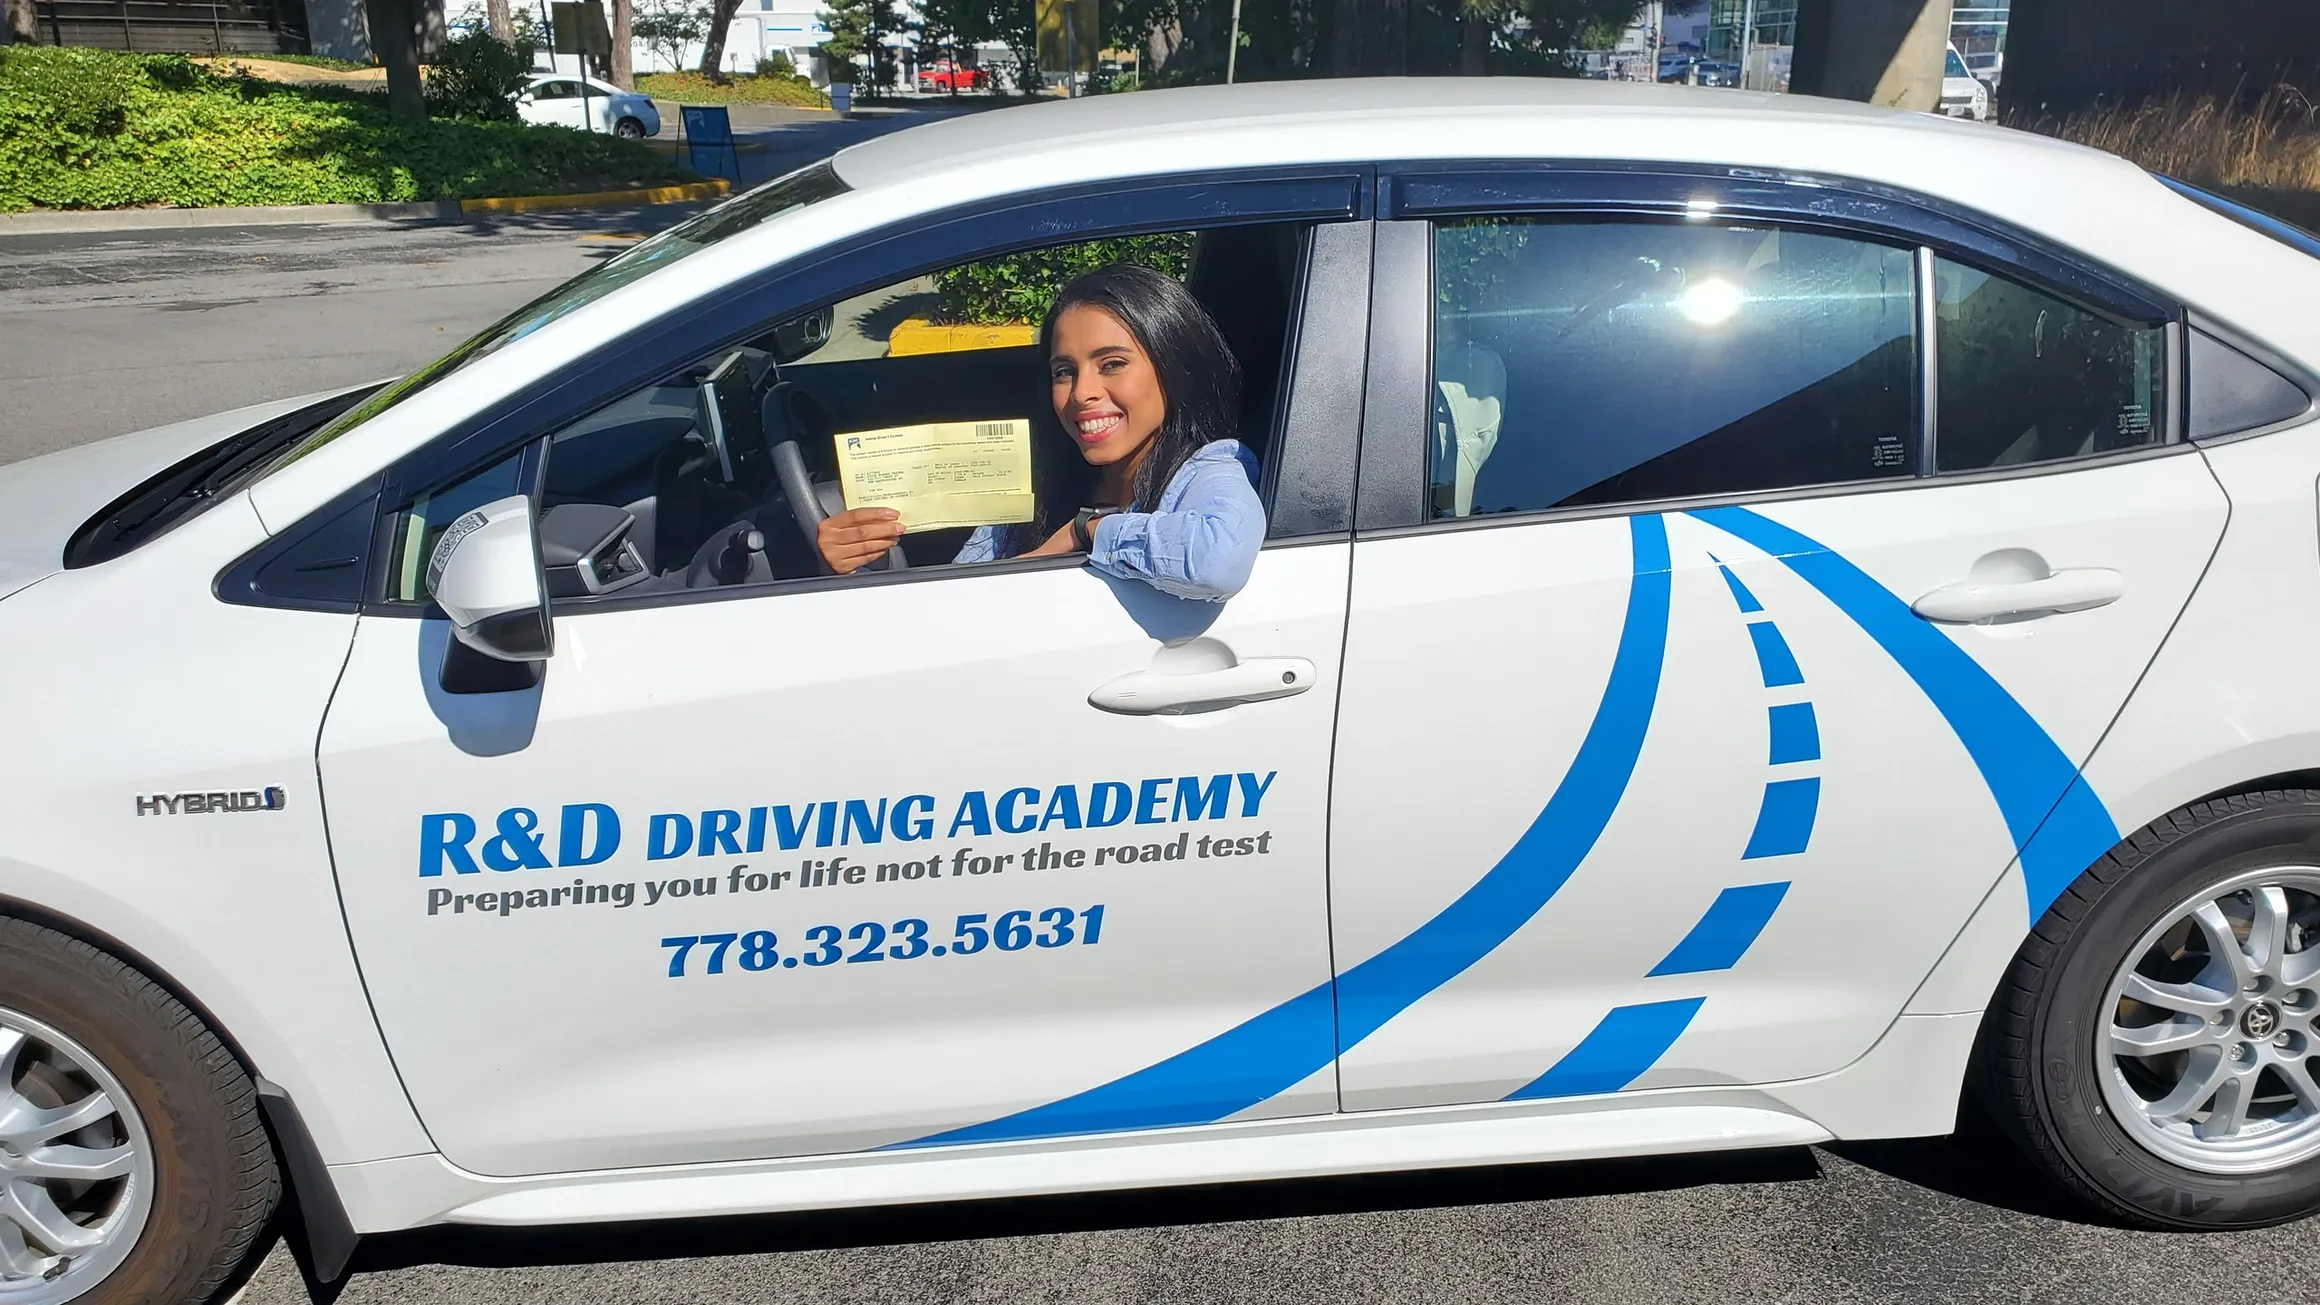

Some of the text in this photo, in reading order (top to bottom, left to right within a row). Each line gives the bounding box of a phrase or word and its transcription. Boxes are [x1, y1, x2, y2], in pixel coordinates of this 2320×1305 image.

[136, 791, 262, 816] HYBRID
[418, 770, 1278, 878] R&D DRIVING ACADEMY
[427, 830, 1273, 917] Preparing you for life not for the road test
[660, 904, 1105, 978] 778.323.5631
